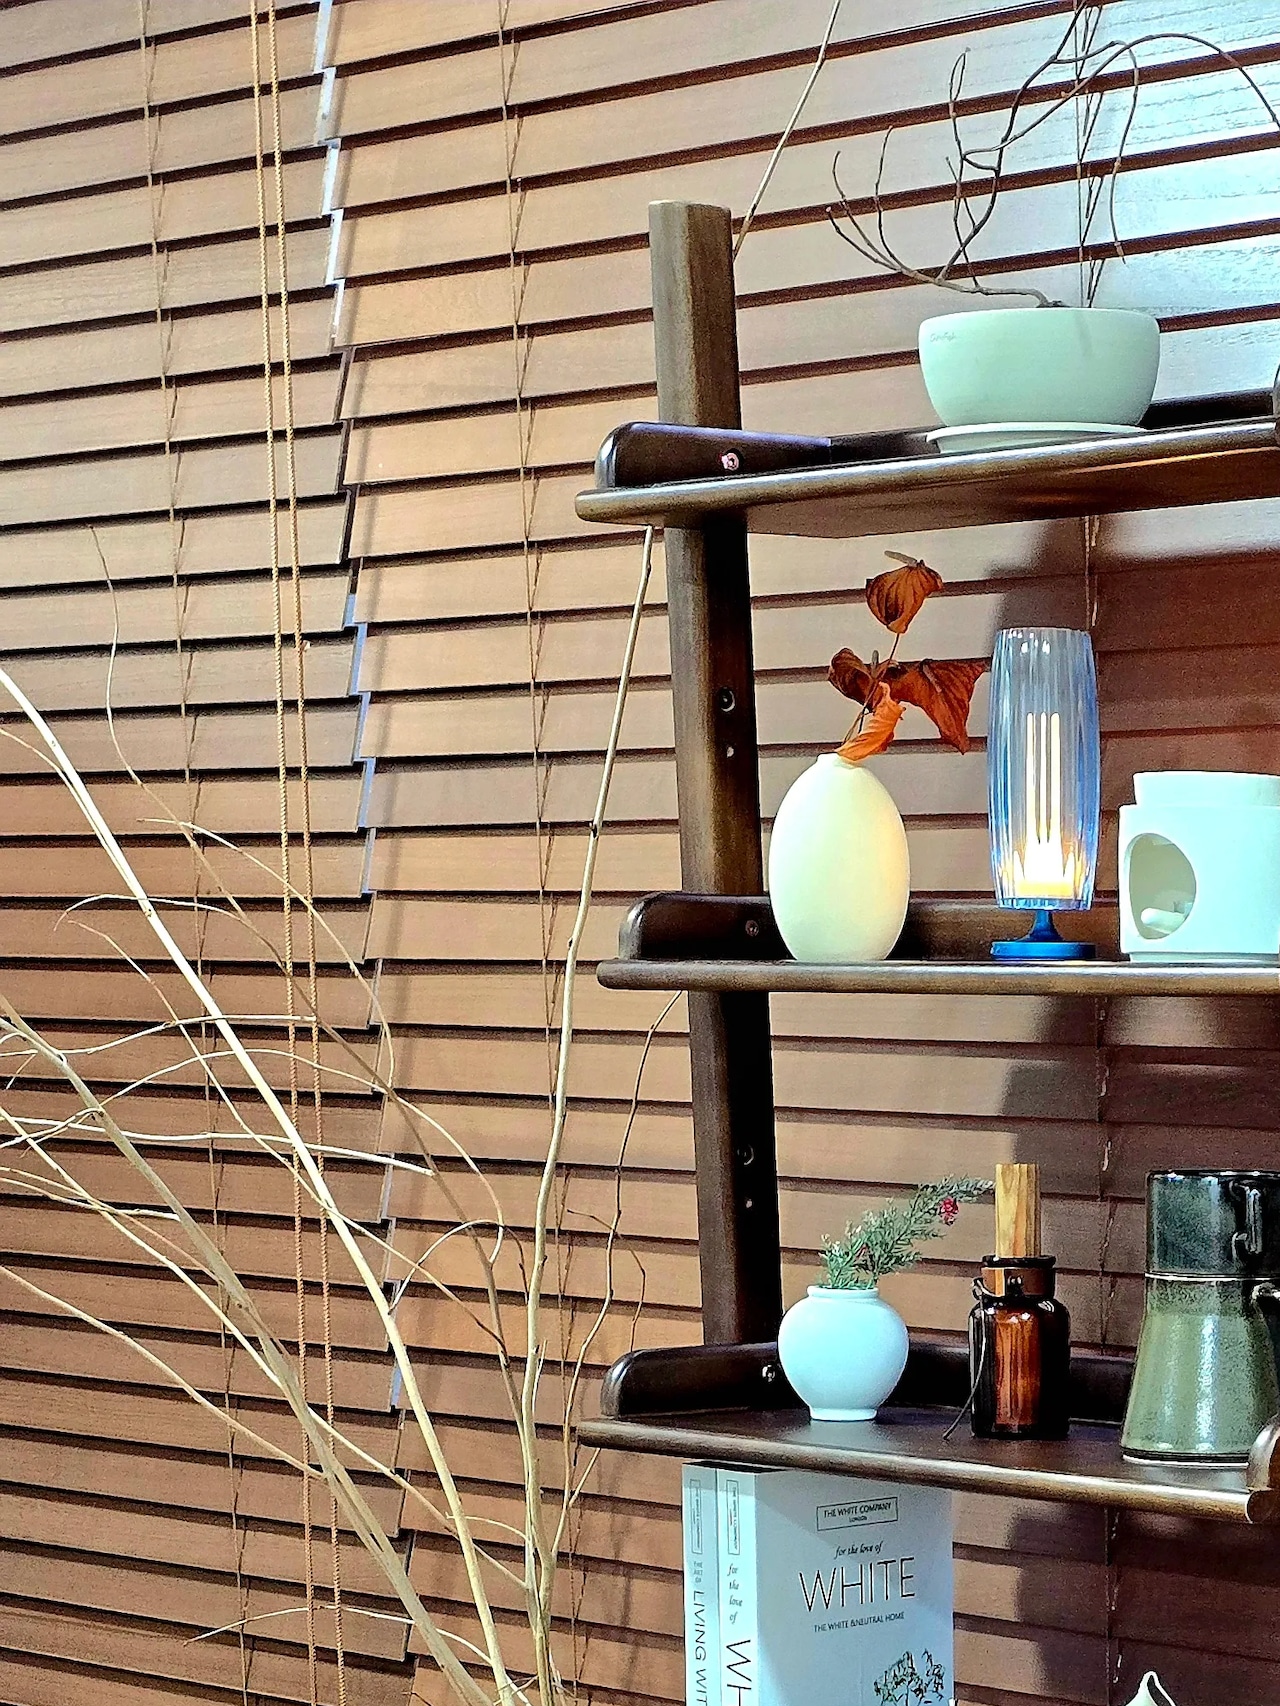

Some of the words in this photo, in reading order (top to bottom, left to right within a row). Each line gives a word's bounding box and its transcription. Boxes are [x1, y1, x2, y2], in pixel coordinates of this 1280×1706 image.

[823, 1508, 837, 1518] THE
[837, 1505, 859, 1516] WHITE
[859, 1502, 892, 1514] COMPANY
[833, 1544, 847, 1560] for
[847, 1543, 859, 1555] the
[859, 1543, 874, 1554] love
[874, 1540, 884, 1555] of
[726, 1562, 738, 1577] for
[729, 1579, 740, 1590] the
[799, 1556, 916, 1612] WHITE
[729, 1594, 743, 1607] love
[693, 1590, 706, 1661] LIVING
[729, 1611, 738, 1625] of
[814, 1624, 828, 1633] THE
[828, 1619, 849, 1631] WHITE
[856, 1614, 884, 1626] NEUTRAL
[885, 1611, 905, 1623] HOME
